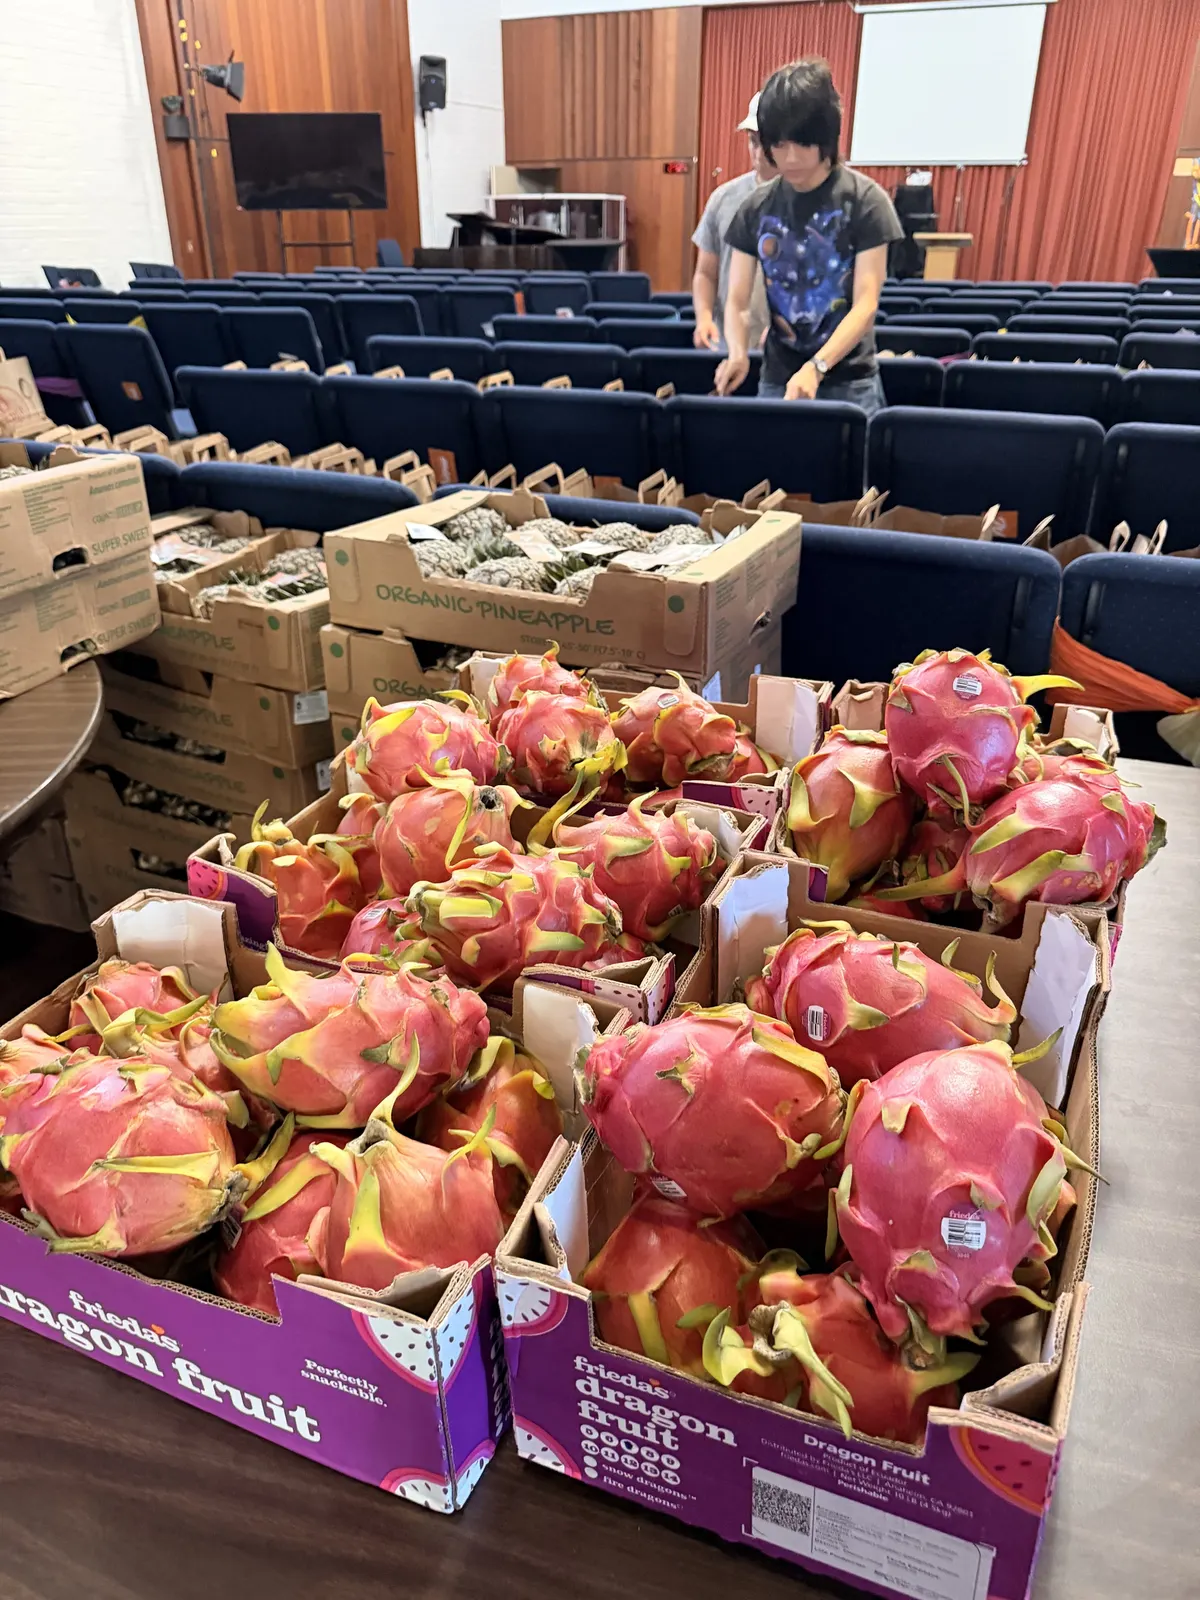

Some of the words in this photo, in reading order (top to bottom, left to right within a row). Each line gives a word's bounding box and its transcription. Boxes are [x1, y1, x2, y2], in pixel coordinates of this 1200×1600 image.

[91, 537, 122, 556] SUPER
[124, 527, 150, 546] SWEET
[375, 584, 473, 614] ORGANIC
[476, 600, 616, 636] PINEAPPLE
[98, 627, 126, 646] SUPER
[128, 613, 157, 634] SWEET
[373, 677, 446, 702] ORGAN
[0, 1284, 164, 1377] ragon
[171, 1357, 321, 1442] fruit
[304, 1358, 379, 1394] Perfectly
[301, 1369, 388, 1407] snackable.
[575, 1376, 738, 1447] dragon
[577, 1400, 680, 1450] fruit
[602, 1464, 634, 1480] snow
[761, 1438, 808, 1459] Distributed
[930, 1497, 944, 1507] CA
[804, 1434, 876, 1467] Dragon
[882, 1460, 931, 1485] Fruit
[603, 1475, 625, 1489] fire
[837, 1479, 889, 1502] Perishable
